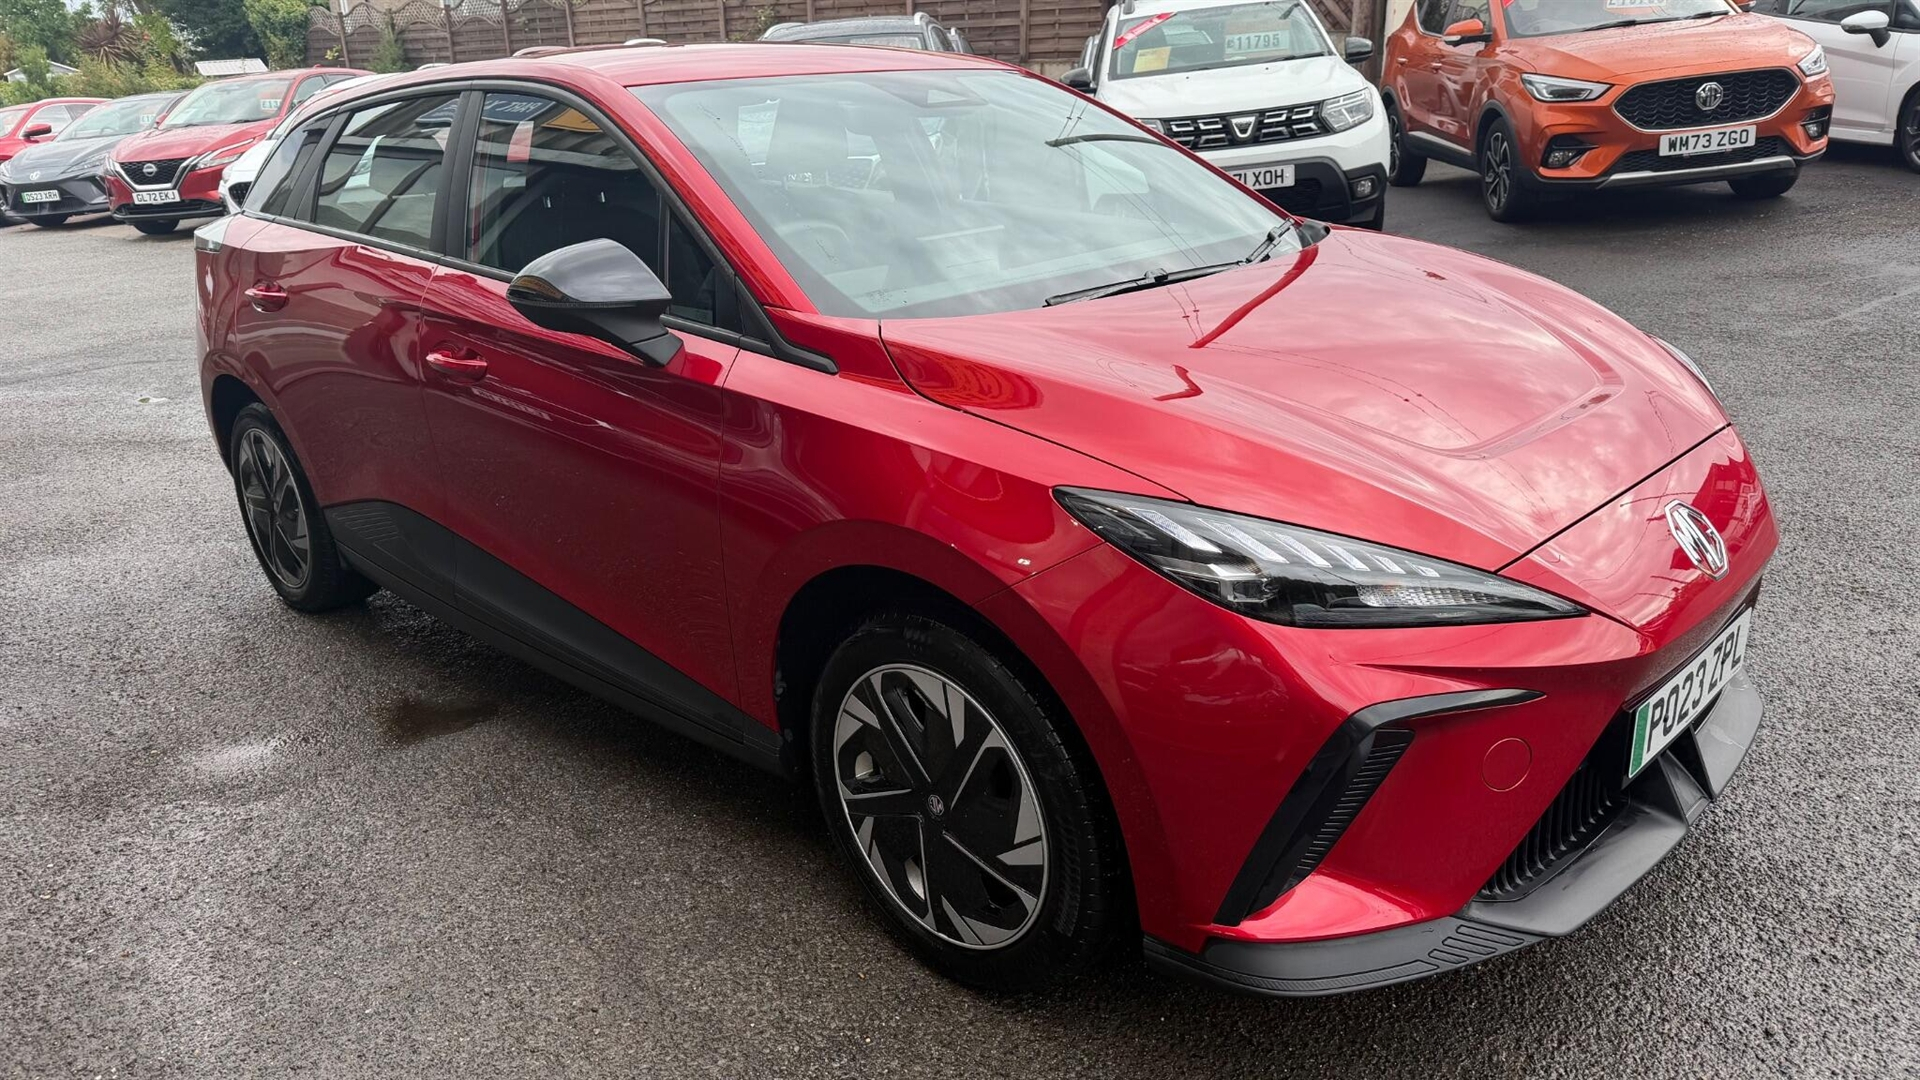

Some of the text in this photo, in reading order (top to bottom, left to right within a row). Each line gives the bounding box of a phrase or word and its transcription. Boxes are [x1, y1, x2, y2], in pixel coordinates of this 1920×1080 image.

[1668, 129, 1749, 153] WM73 ZGO
[1252, 169, 1284, 187] XOH
[136, 191, 176, 202] GL72 EKJ
[1667, 503, 1727, 577] MG
[1646, 624, 1742, 754] PO23 ZPL
